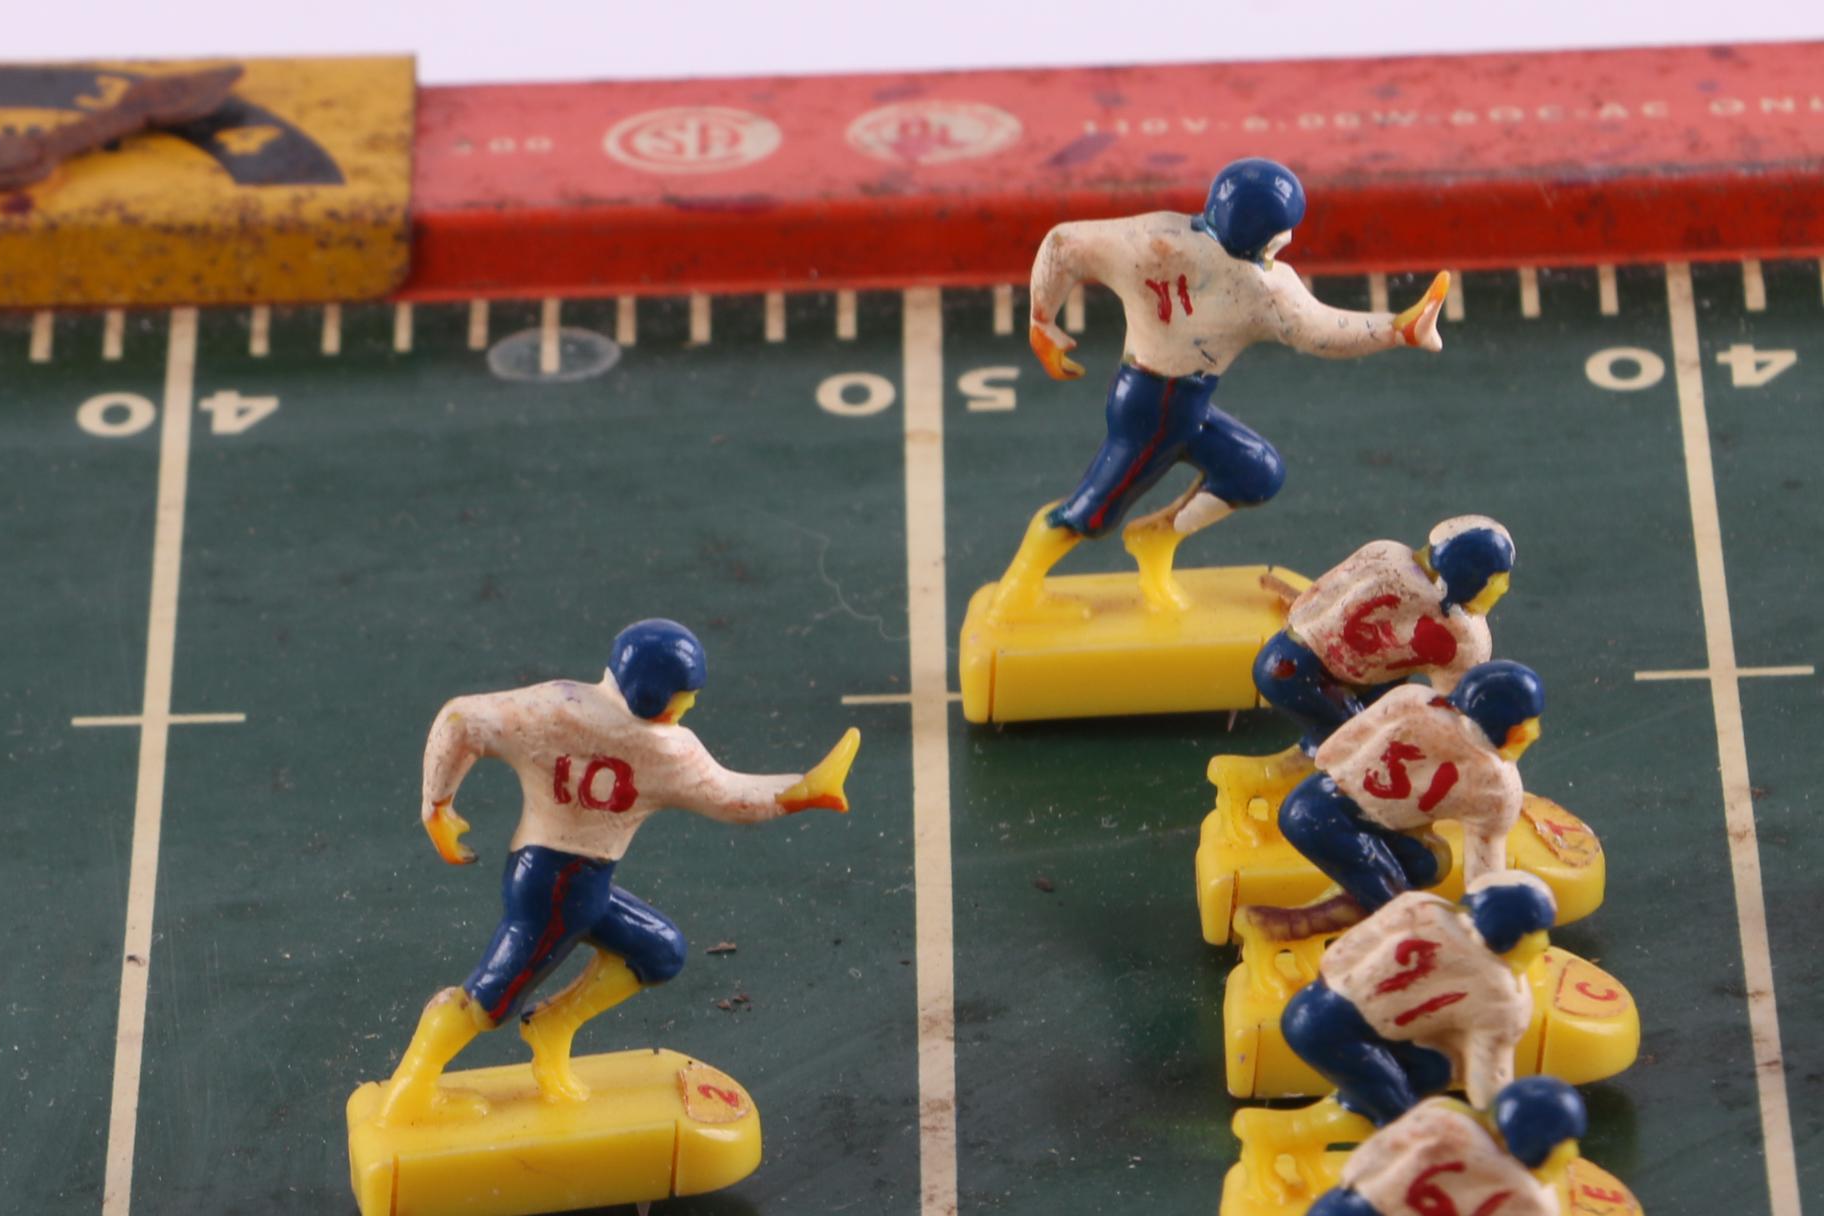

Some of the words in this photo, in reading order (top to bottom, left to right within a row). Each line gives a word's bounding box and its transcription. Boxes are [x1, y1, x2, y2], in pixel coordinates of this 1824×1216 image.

[215, 125, 282, 155] 4
[553, 754, 640, 815] 10
[1363, 740, 1460, 815] 51
[697, 1083, 740, 1108] 2
